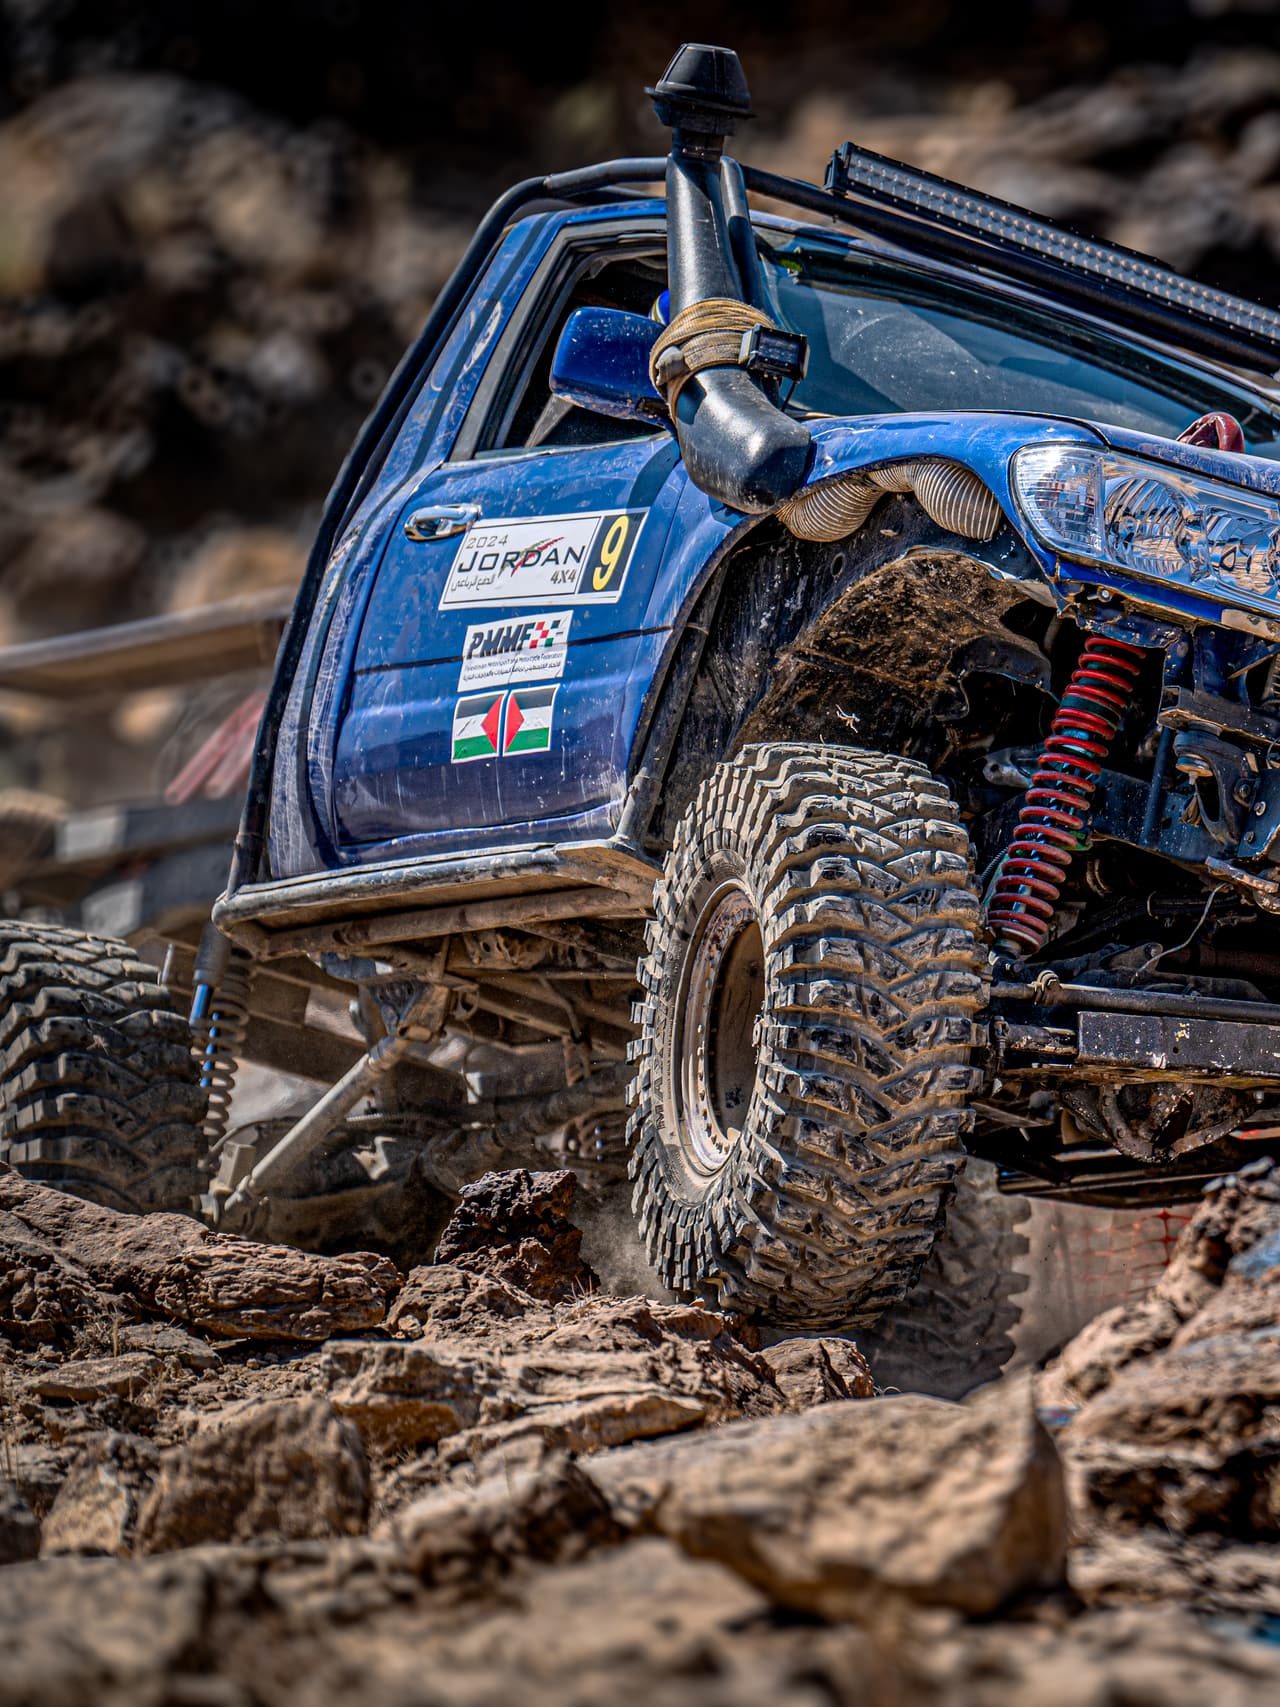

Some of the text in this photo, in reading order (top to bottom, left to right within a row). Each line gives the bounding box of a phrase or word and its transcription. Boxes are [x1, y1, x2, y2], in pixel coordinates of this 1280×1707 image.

[465, 534, 509, 550] 2024
[592, 515, 630, 591] 9
[457, 545, 586, 573] JORDAN
[466, 622, 536, 659] PMMF
